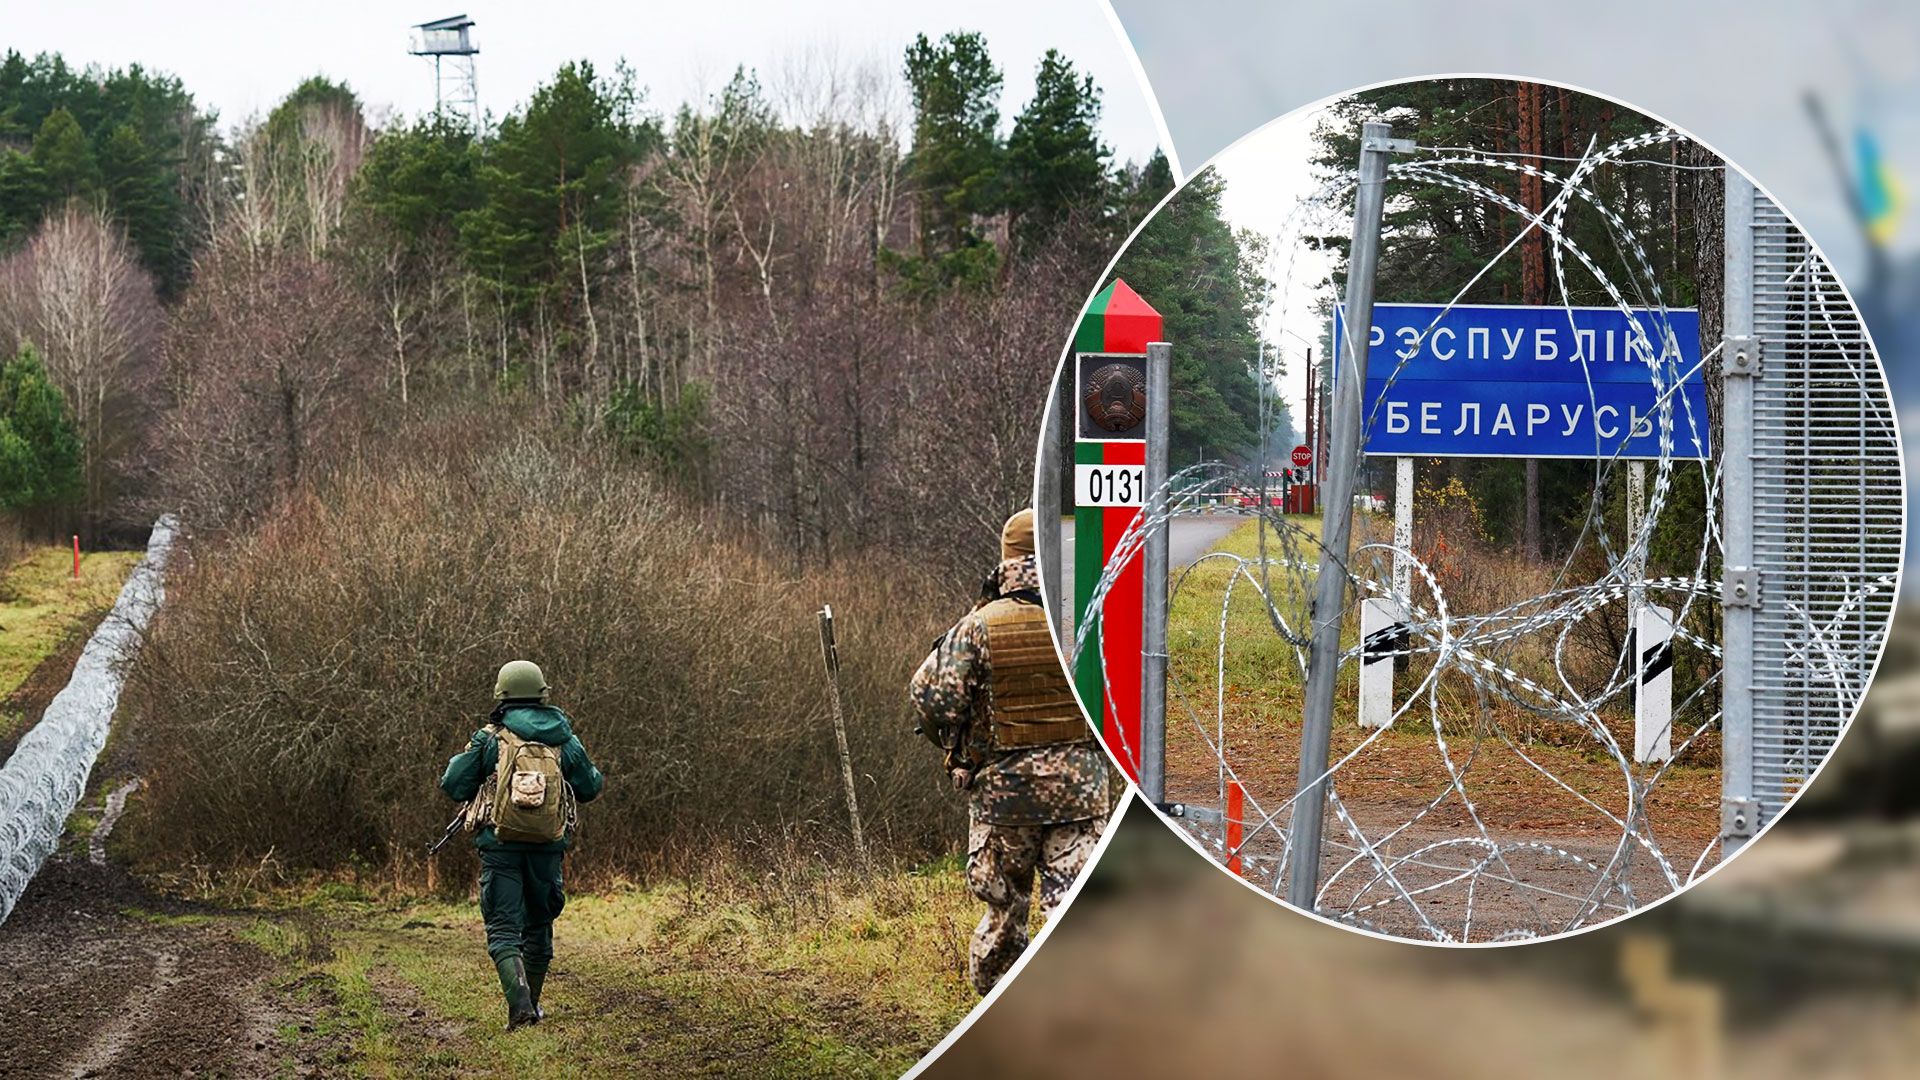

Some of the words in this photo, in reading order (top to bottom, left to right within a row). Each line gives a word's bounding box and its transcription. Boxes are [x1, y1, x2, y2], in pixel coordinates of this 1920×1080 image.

[1386, 401, 1653, 438] БЕЛАРУСЬ
[1292, 453, 1312, 461] STOP
[1090, 468, 1143, 503] 0131
